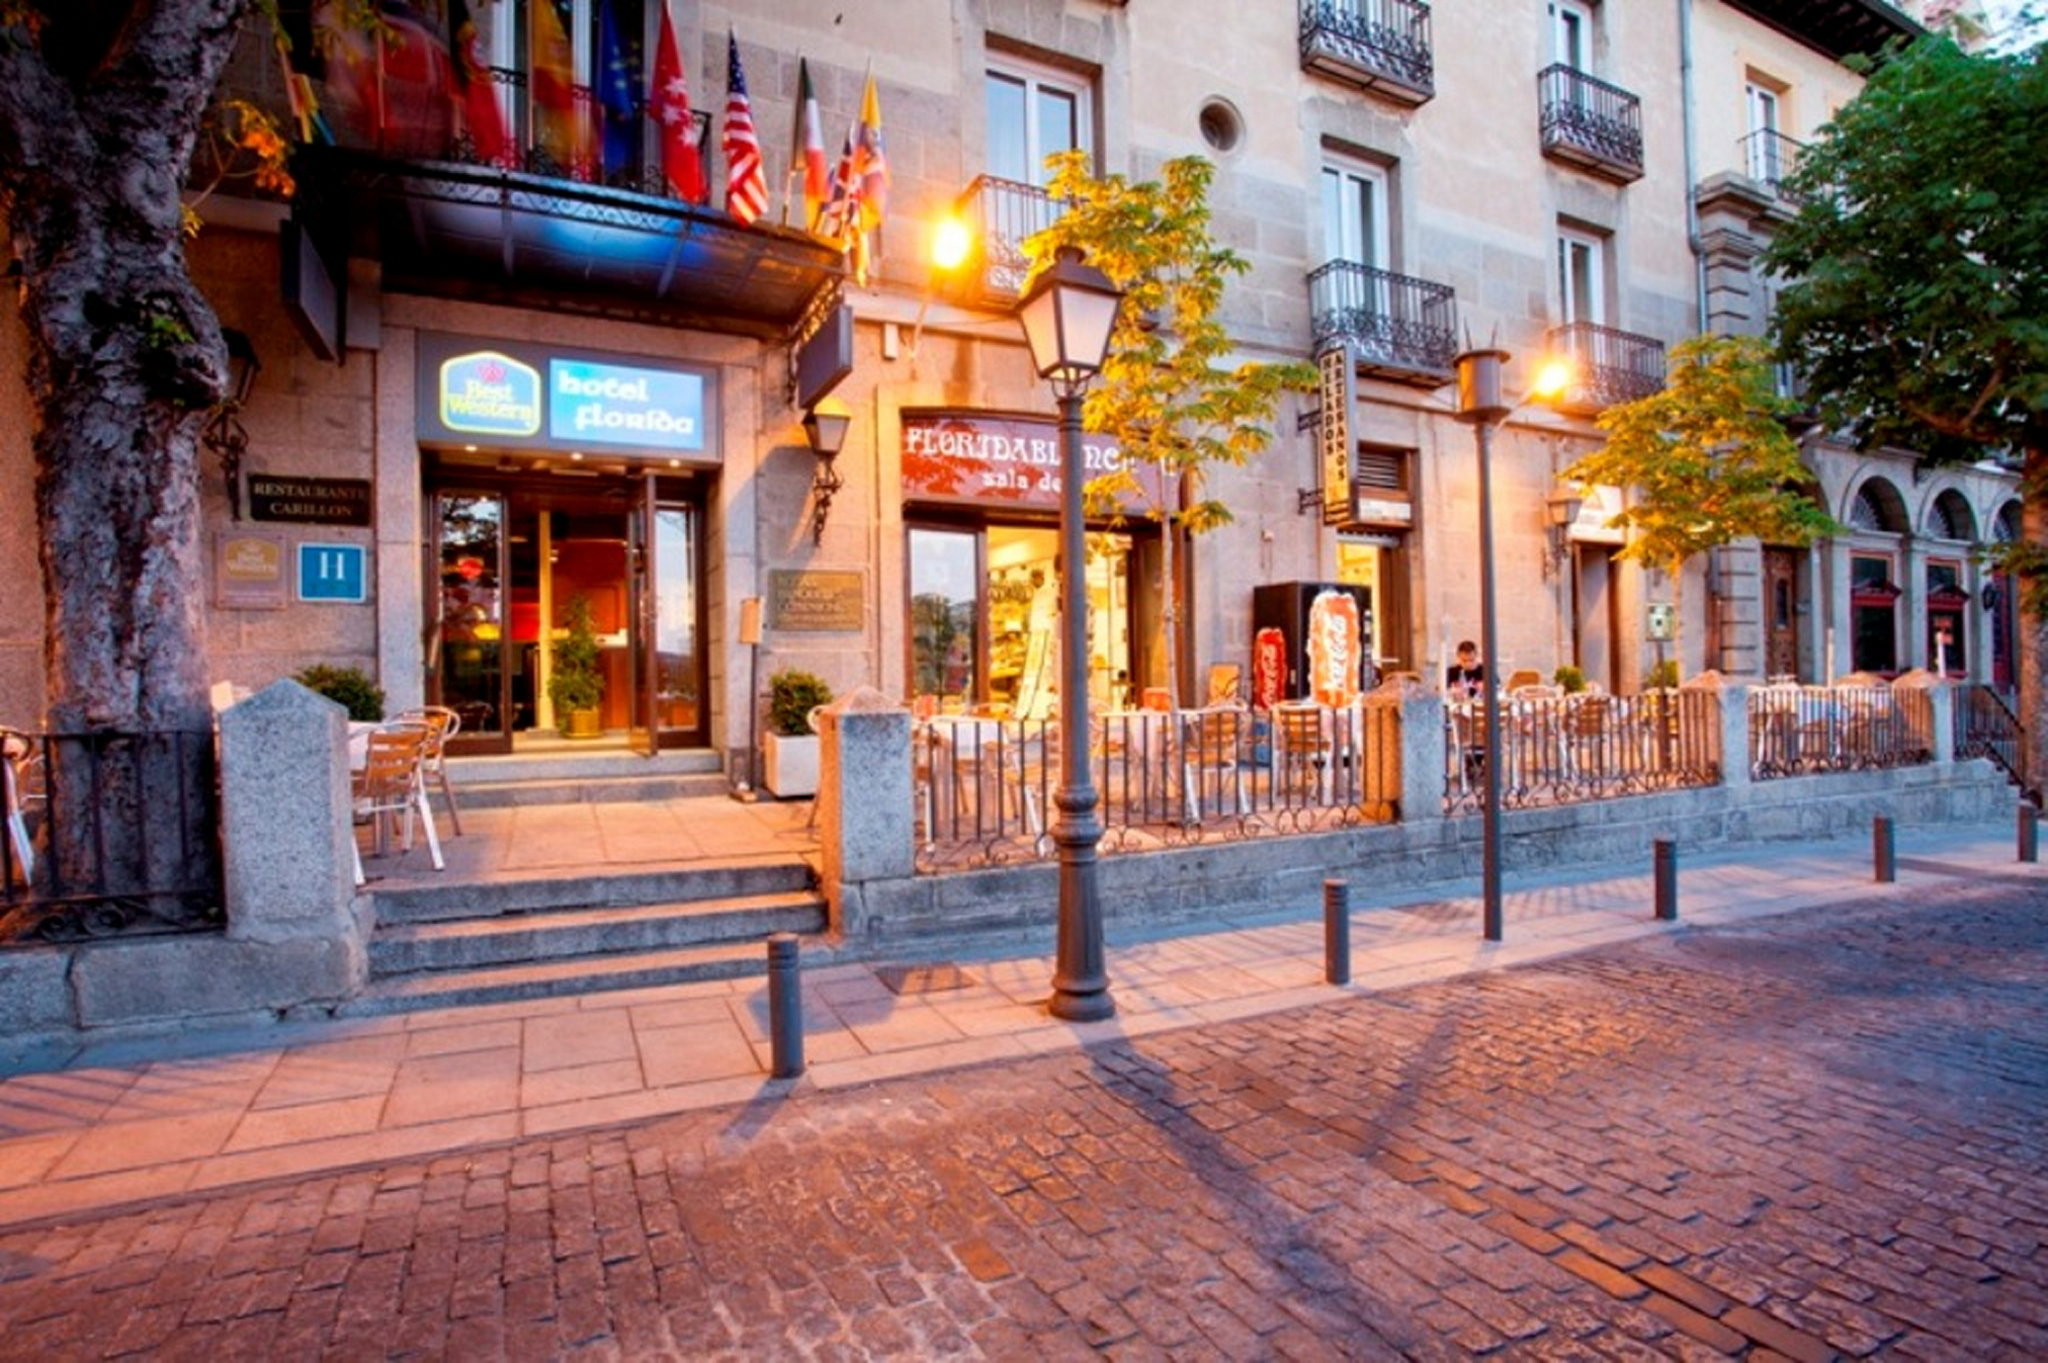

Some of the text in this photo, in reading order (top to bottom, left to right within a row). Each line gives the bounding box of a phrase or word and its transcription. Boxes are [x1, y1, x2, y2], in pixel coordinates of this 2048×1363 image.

[557, 369, 649, 401] hotel
[574, 402, 695, 434] florida
[253, 482, 365, 500] RESTAURANTE
[269, 502, 352, 517] CARILLON
[319, 551, 346, 581] H
